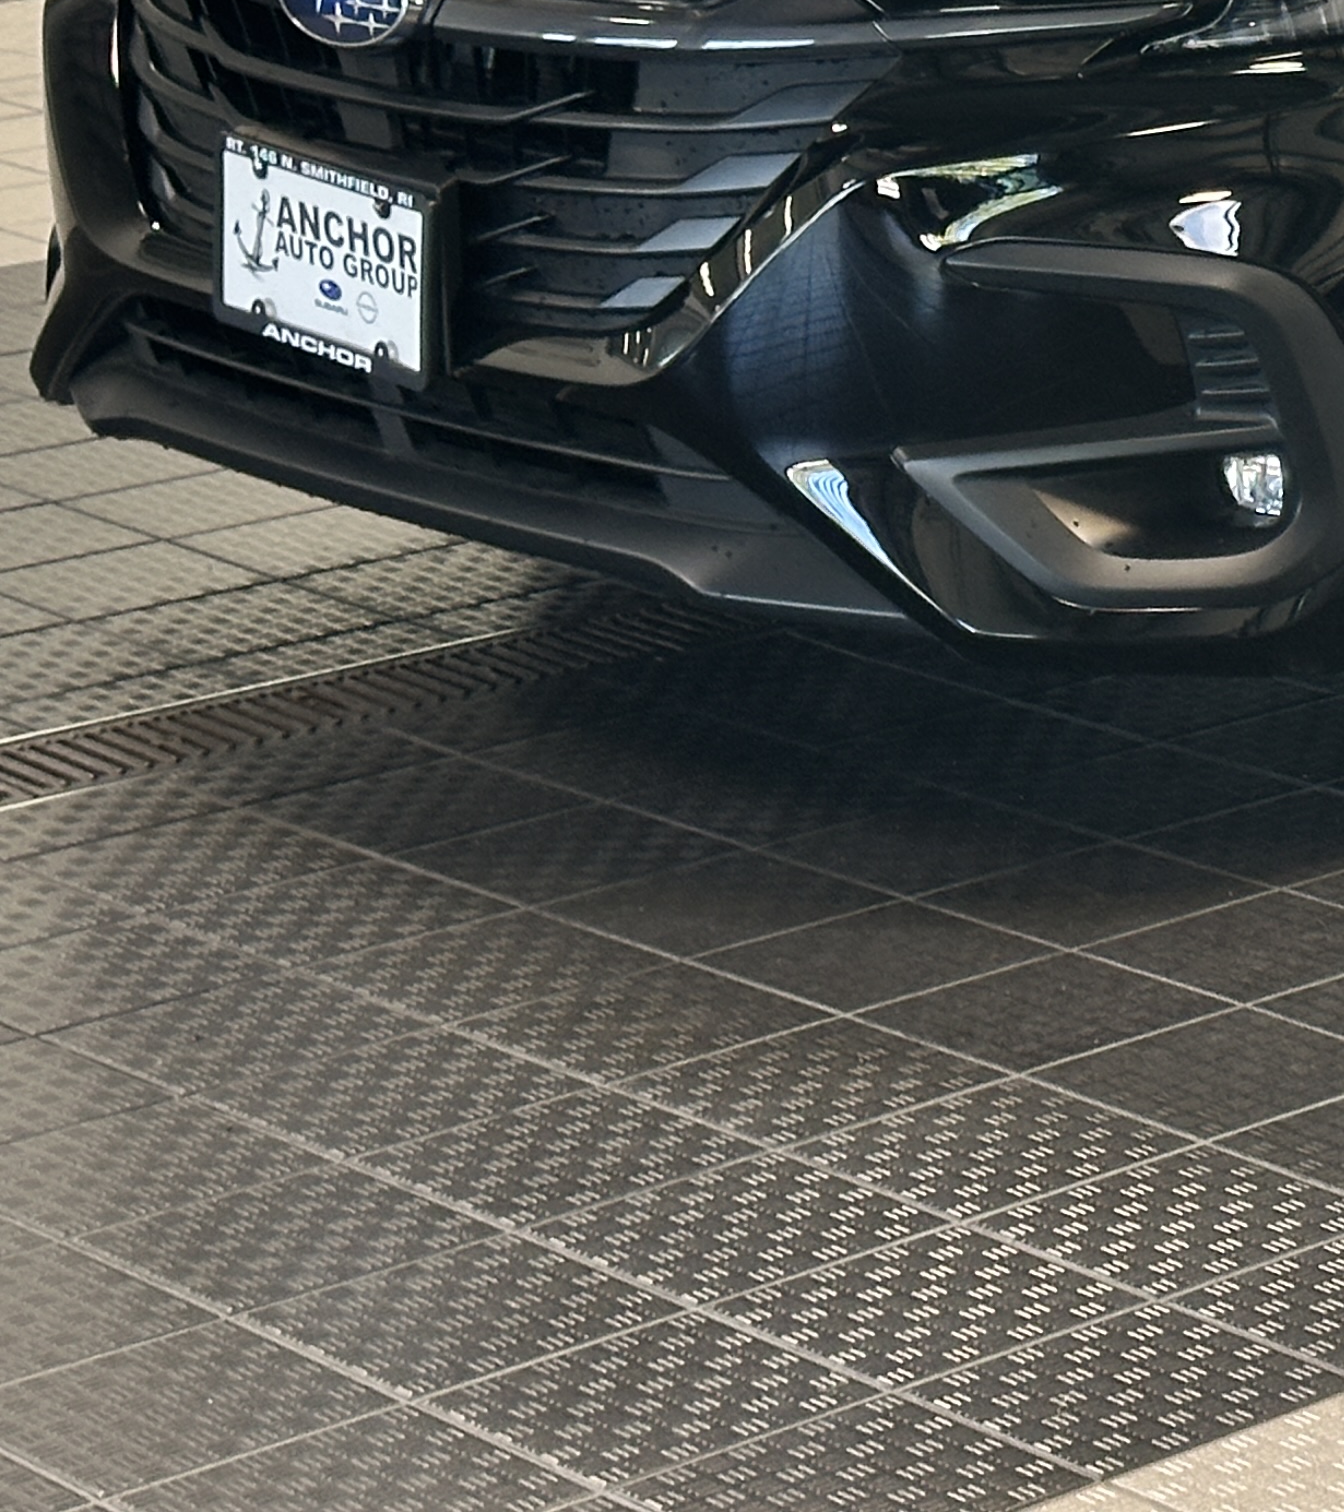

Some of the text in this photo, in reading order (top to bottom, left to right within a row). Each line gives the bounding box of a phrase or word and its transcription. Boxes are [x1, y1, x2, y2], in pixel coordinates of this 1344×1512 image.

[300, 161, 394, 205] SMITHFIELD,
[397, 191, 414, 209] RI
[275, 230, 418, 299] AUTO GROUP
[276, 196, 418, 275] ANCHOR
[262, 322, 372, 374] ANCHOR
